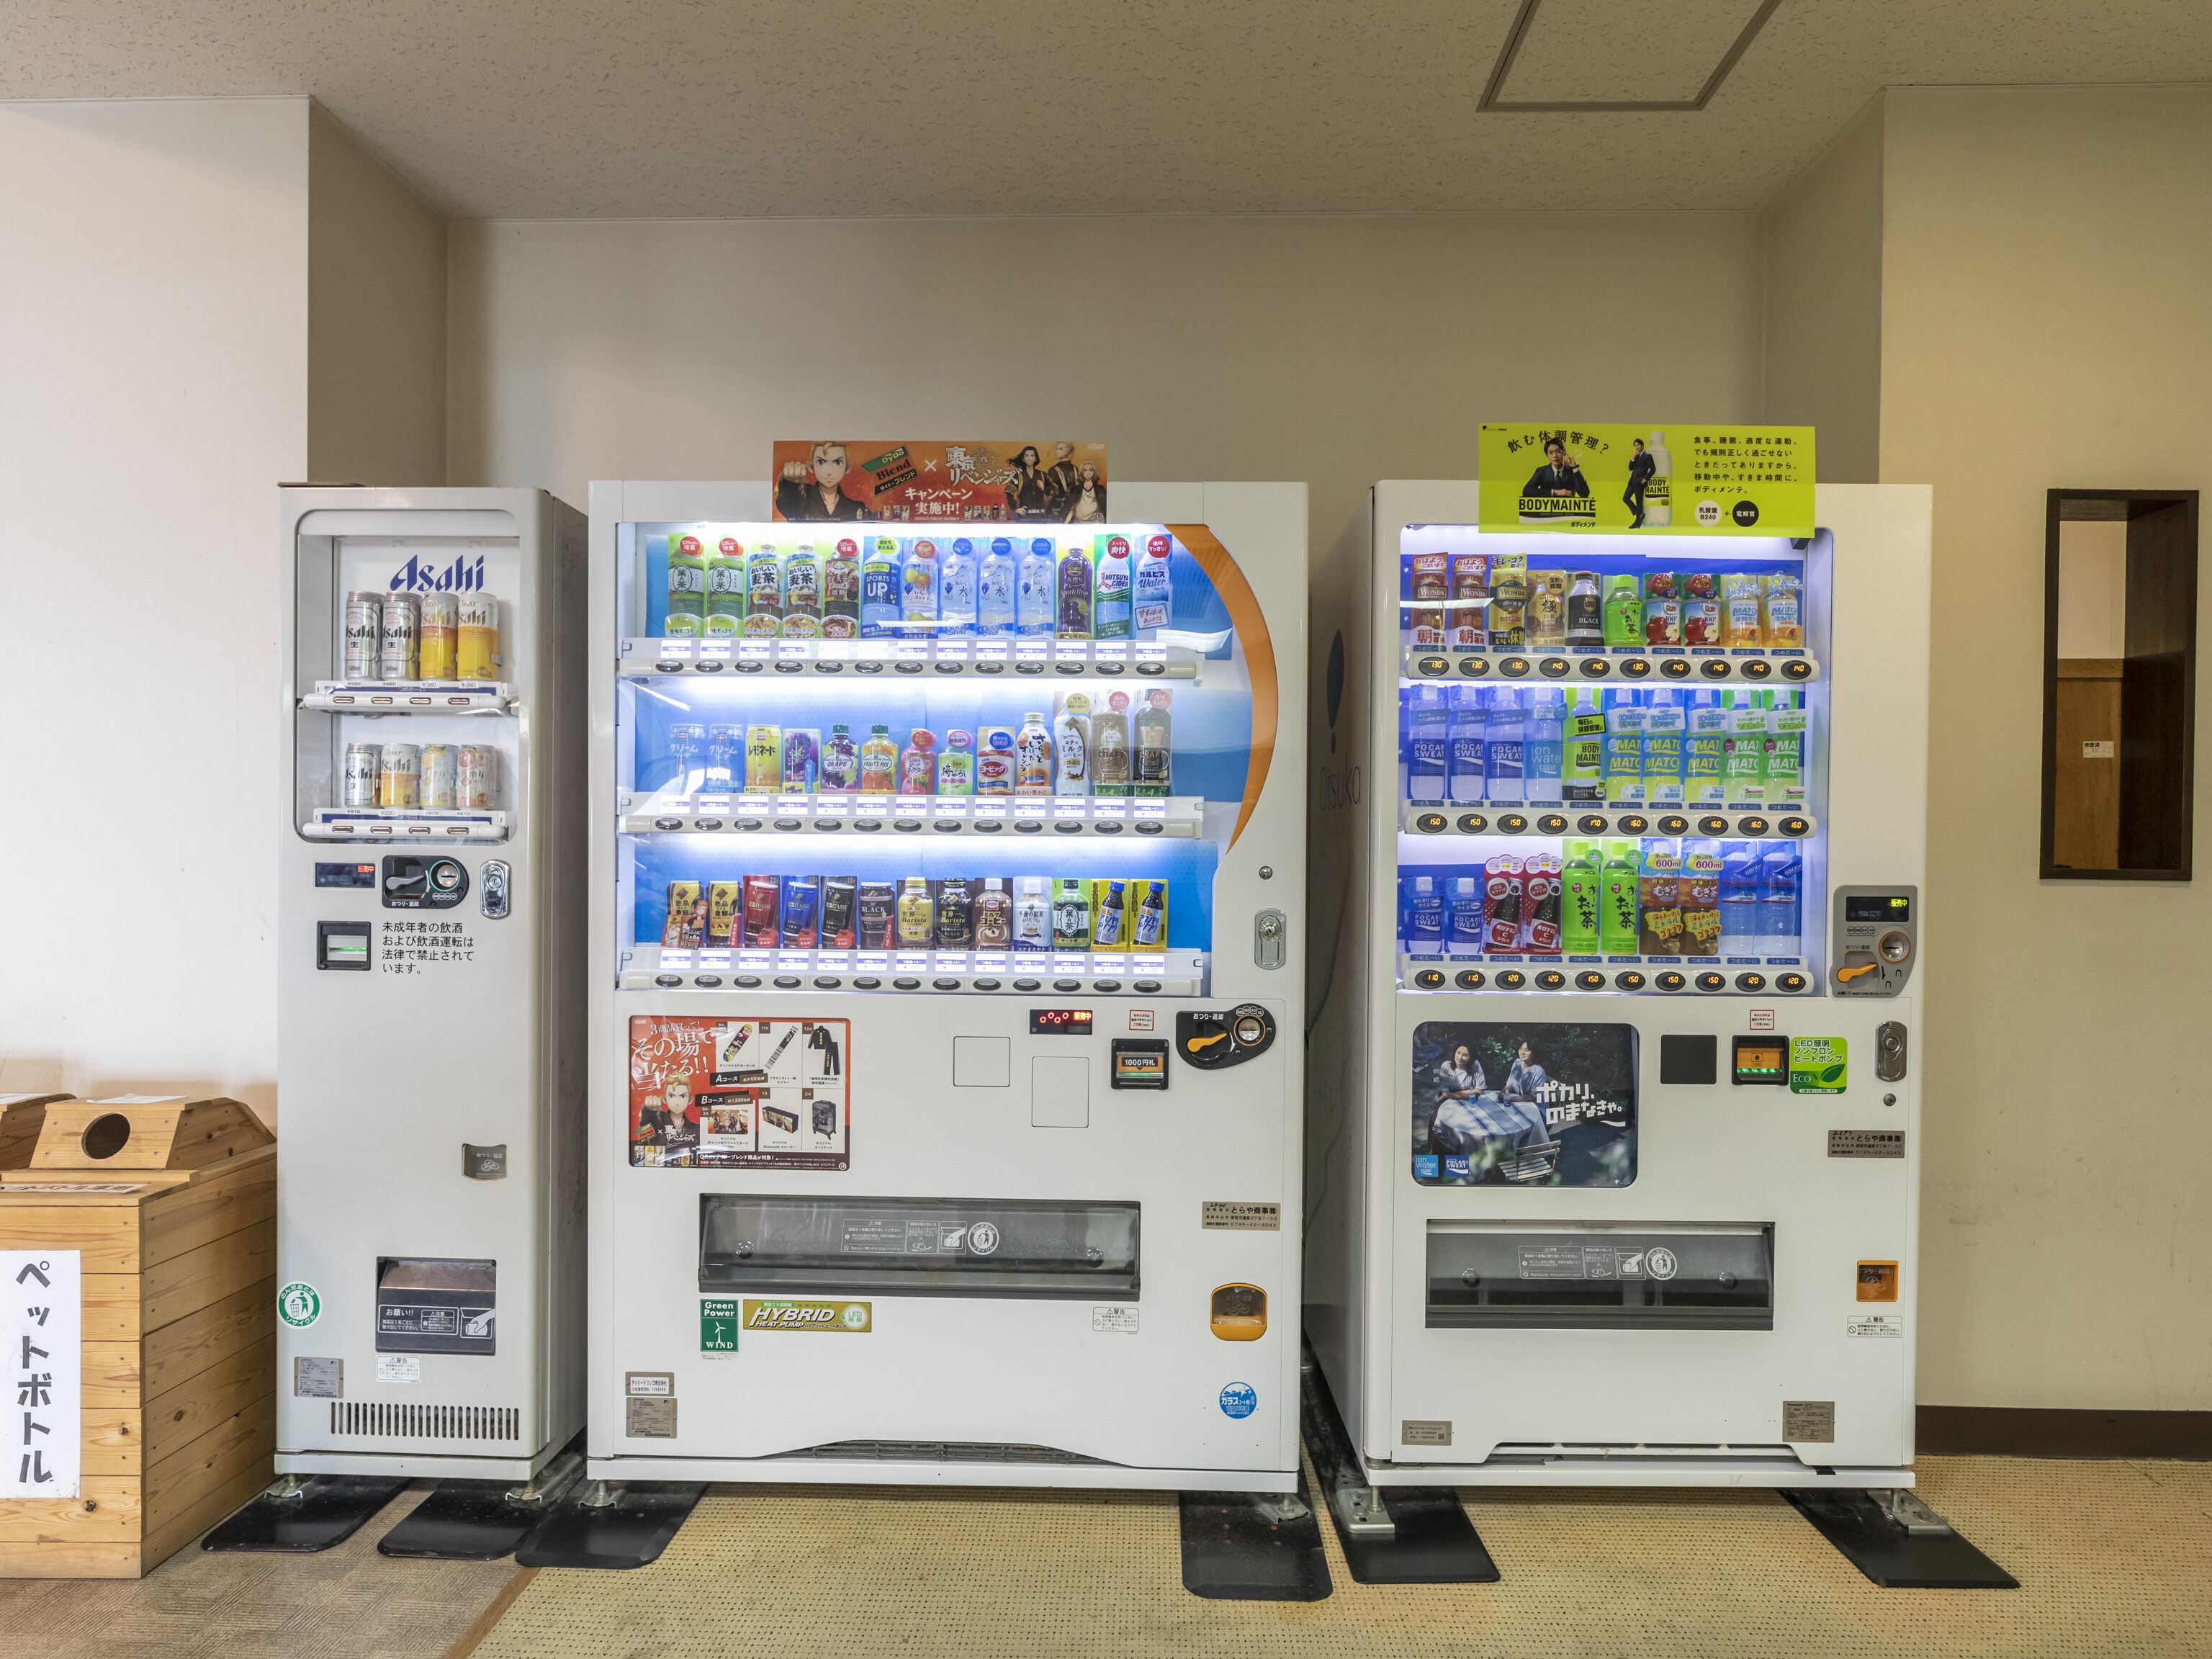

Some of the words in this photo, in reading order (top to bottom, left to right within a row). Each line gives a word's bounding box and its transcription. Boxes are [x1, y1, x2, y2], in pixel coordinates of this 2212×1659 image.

[1694, 436, 1797, 445] 食事、睡眠、適度な運動。
[881, 449, 905, 464] DyDo
[1694, 449, 1792, 457] でも規則正しく過ごせない
[875, 459, 912, 482] Blend
[1694, 461, 1797, 469] ときだってありますから。
[879, 470, 916, 492] ダイドーブレンド
[950, 467, 1022, 487] リベンジャーズ
[1694, 473, 1798, 482] 移動中や、すきま時間に、
[904, 487, 973, 500] キャンペーン
[1694, 485, 1748, 494] ボディメンテ。
[914, 503, 960, 516] 実施中!
[1110, 546, 1126, 554] 爽快
[1414, 557, 1443, 565] おはよう
[1457, 558, 1484, 567] おはよう
[390, 554, 484, 592] Asahi
[751, 572, 775, 585] 麦茶
[677, 569, 687, 589] 葉の茶
[716, 570, 726, 590] 葉の茶
[789, 574, 814, 586] 麦茶
[1138, 577, 1166, 588] Water
[867, 583, 888, 597] UP
[958, 586, 969, 597] 水
[996, 586, 1004, 597] 水
[1036, 586, 1046, 597] 水
[1420, 587, 1445, 596] WONDA
[1462, 588, 1486, 598] WONDA
[1501, 588, 1526, 597] WONDA
[1542, 600, 1557, 613] 極
[1417, 629, 1432, 644] 朝
[1459, 629, 1474, 644] 朝
[748, 745, 775, 755] レモネード
[1531, 746, 1550, 755] ion
[1019, 745, 1031, 772] オレンジ
[941, 763, 966, 778] 梅よろし
[980, 765, 1005, 773] ヨービック
[1655, 859, 1681, 868] 600ml
[1696, 860, 1722, 869] 600ml
[1653, 885, 1678, 896] むぎ茶
[1692, 886, 1717, 898] むぎ茶
[1891, 899, 1907, 907] 販売中
[981, 917, 1006, 925] コーヒー
[382, 922, 463, 933] 未成年者の飲酒
[382, 935, 475, 948] および飲酒運転は
[382, 949, 475, 961] 法律で禁止されて
[382, 963, 422, 974] います。
[1074, 1012, 1092, 1021] 販売中
[635, 1030, 716, 1061] その場で
[1794, 1039, 1830, 1048] LED照明
[1124, 1058, 1156, 1067] 1000円札
[715, 1074, 738, 1083] Aコース
[701, 1095, 723, 1105] Bコース
[280, 1284, 316, 1300] のんだあとは
[704, 1301, 734, 1310] Green
[703, 1309, 735, 1318] Power
[749, 1306, 835, 1327] HYBRID
[286, 1313, 317, 1327] リサイクル
[706, 1341, 734, 1349] WIND
[15, 1259, 54, 1485] ペットボトル
[1221, 1396, 1238, 1405] ガラス
